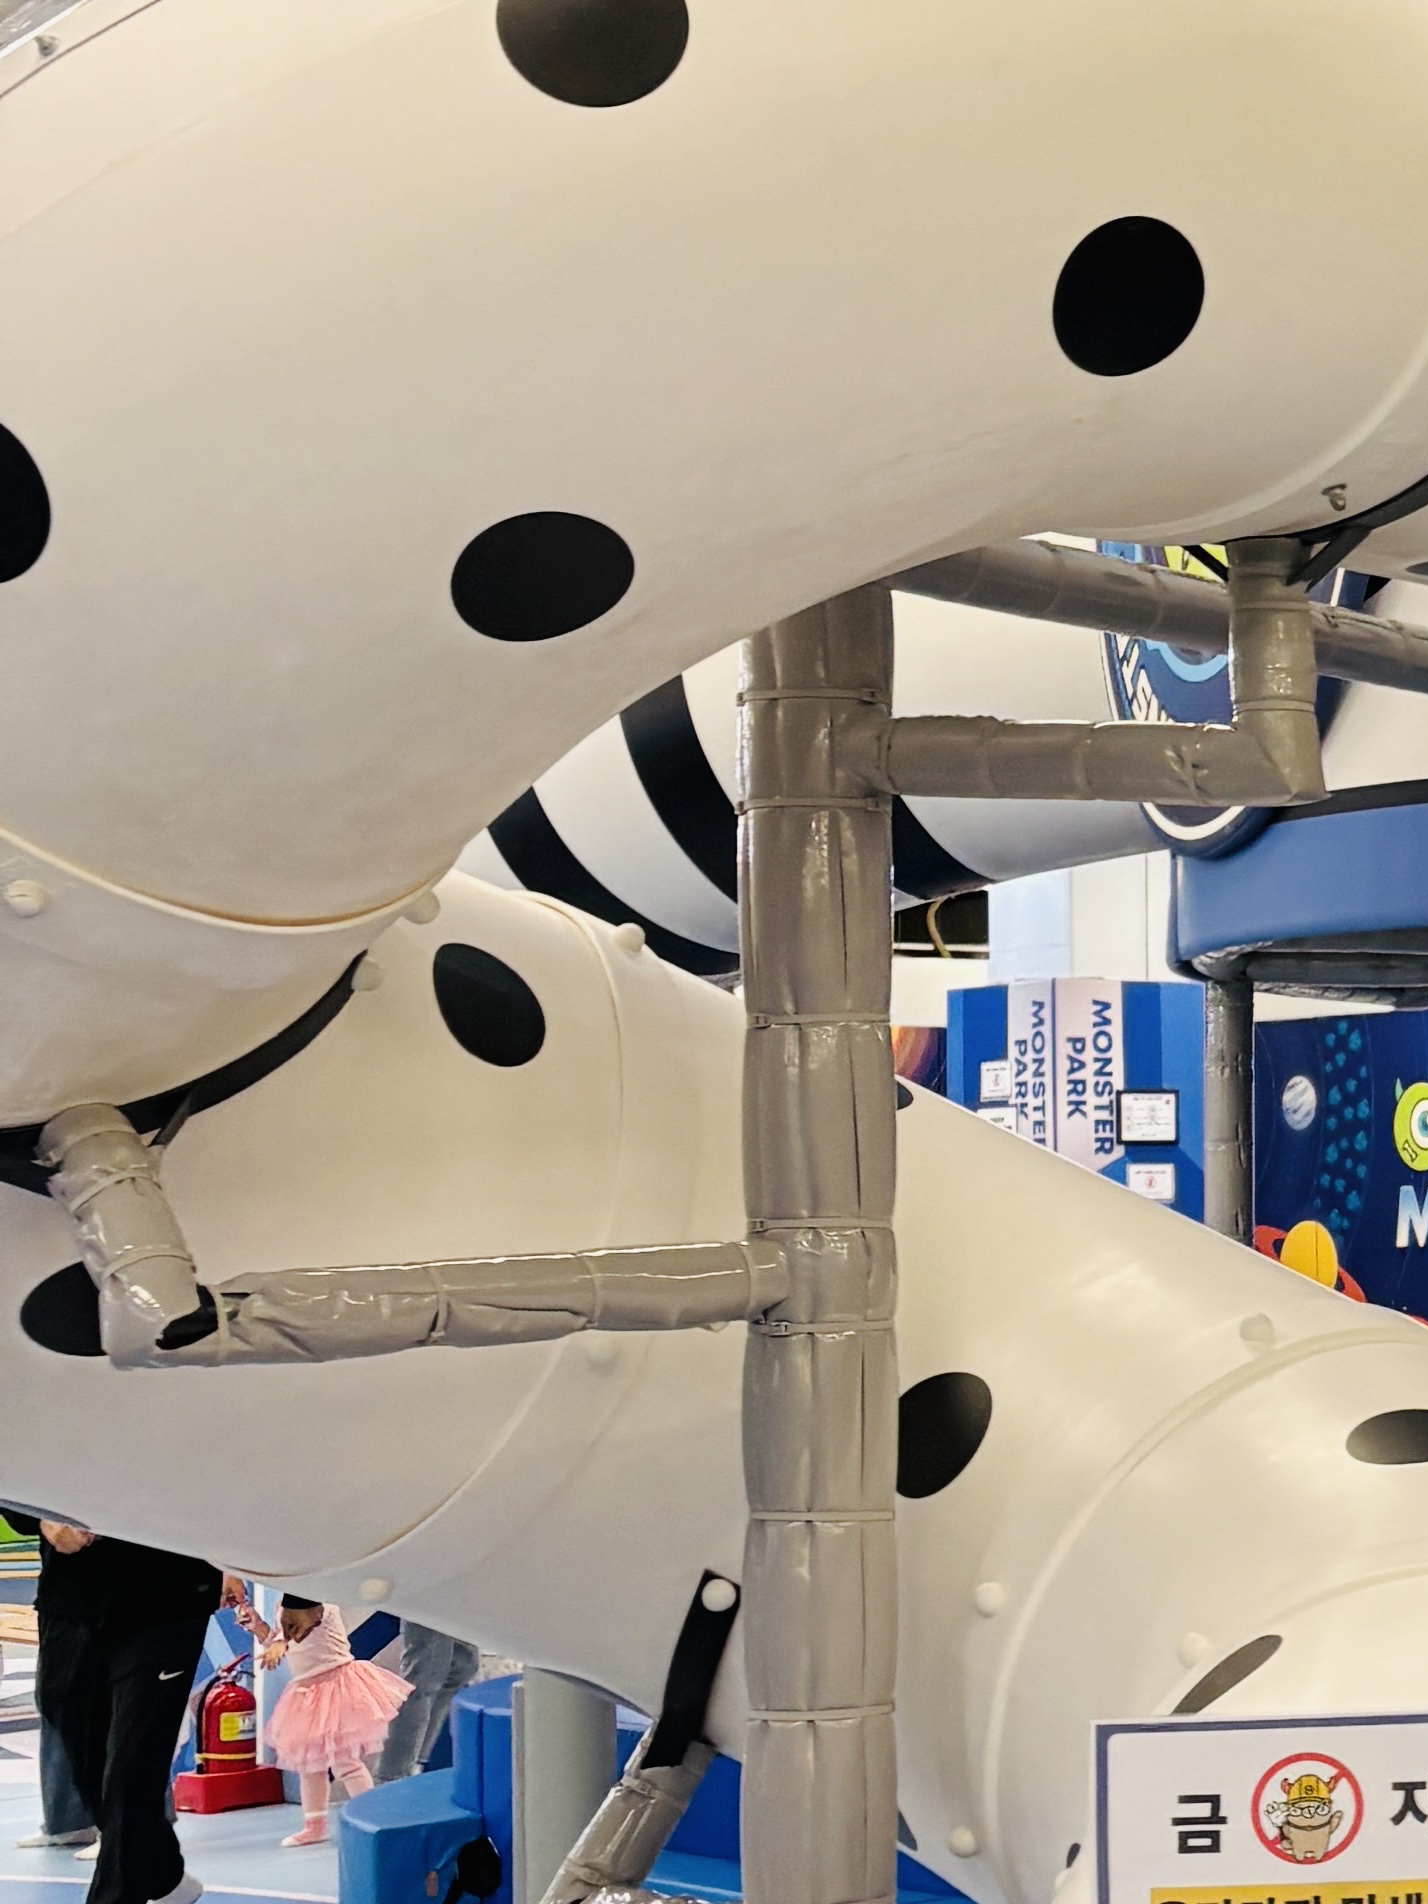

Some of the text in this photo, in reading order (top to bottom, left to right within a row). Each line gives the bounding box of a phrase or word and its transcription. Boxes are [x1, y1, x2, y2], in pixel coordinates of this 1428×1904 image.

[1066, 1036, 1087, 1119] PARK
[1091, 999, 1114, 1155] MONSTER
[1170, 1793, 1228, 1854] 금
